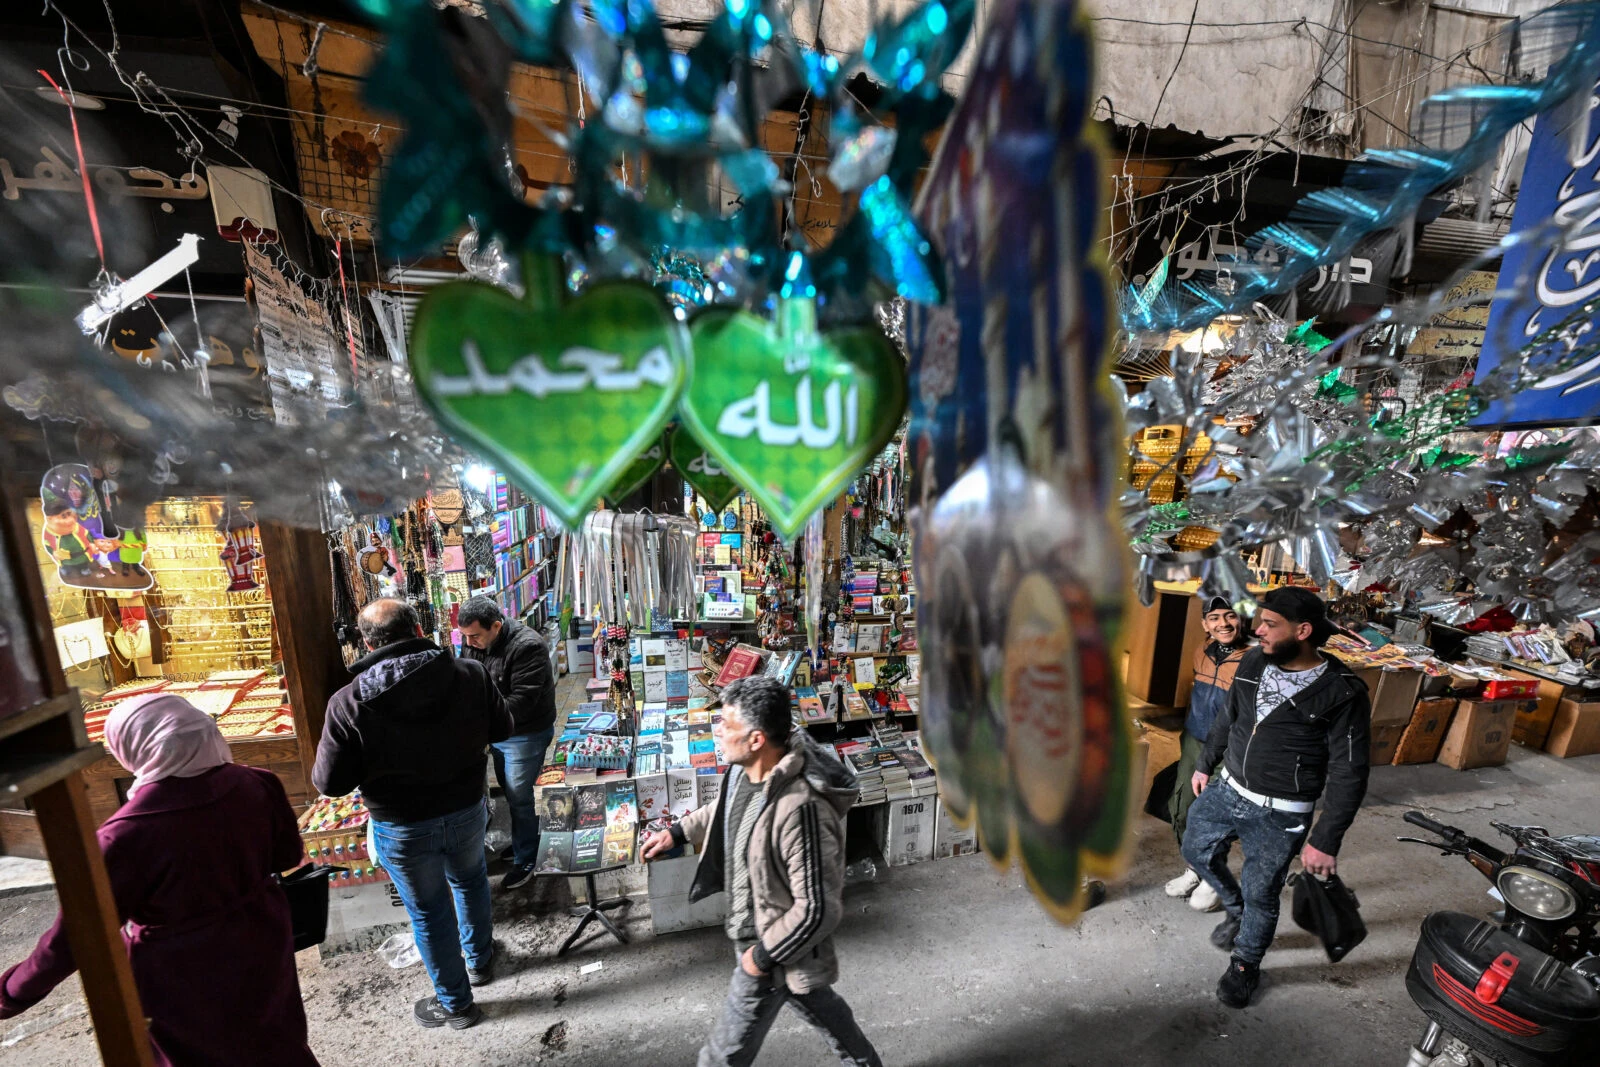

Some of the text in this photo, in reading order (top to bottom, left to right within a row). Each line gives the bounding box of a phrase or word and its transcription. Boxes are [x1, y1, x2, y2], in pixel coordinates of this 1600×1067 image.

[430, 339, 672, 398] محمد
[716, 349, 860, 448] الله
[903, 803, 924, 815] 1970
